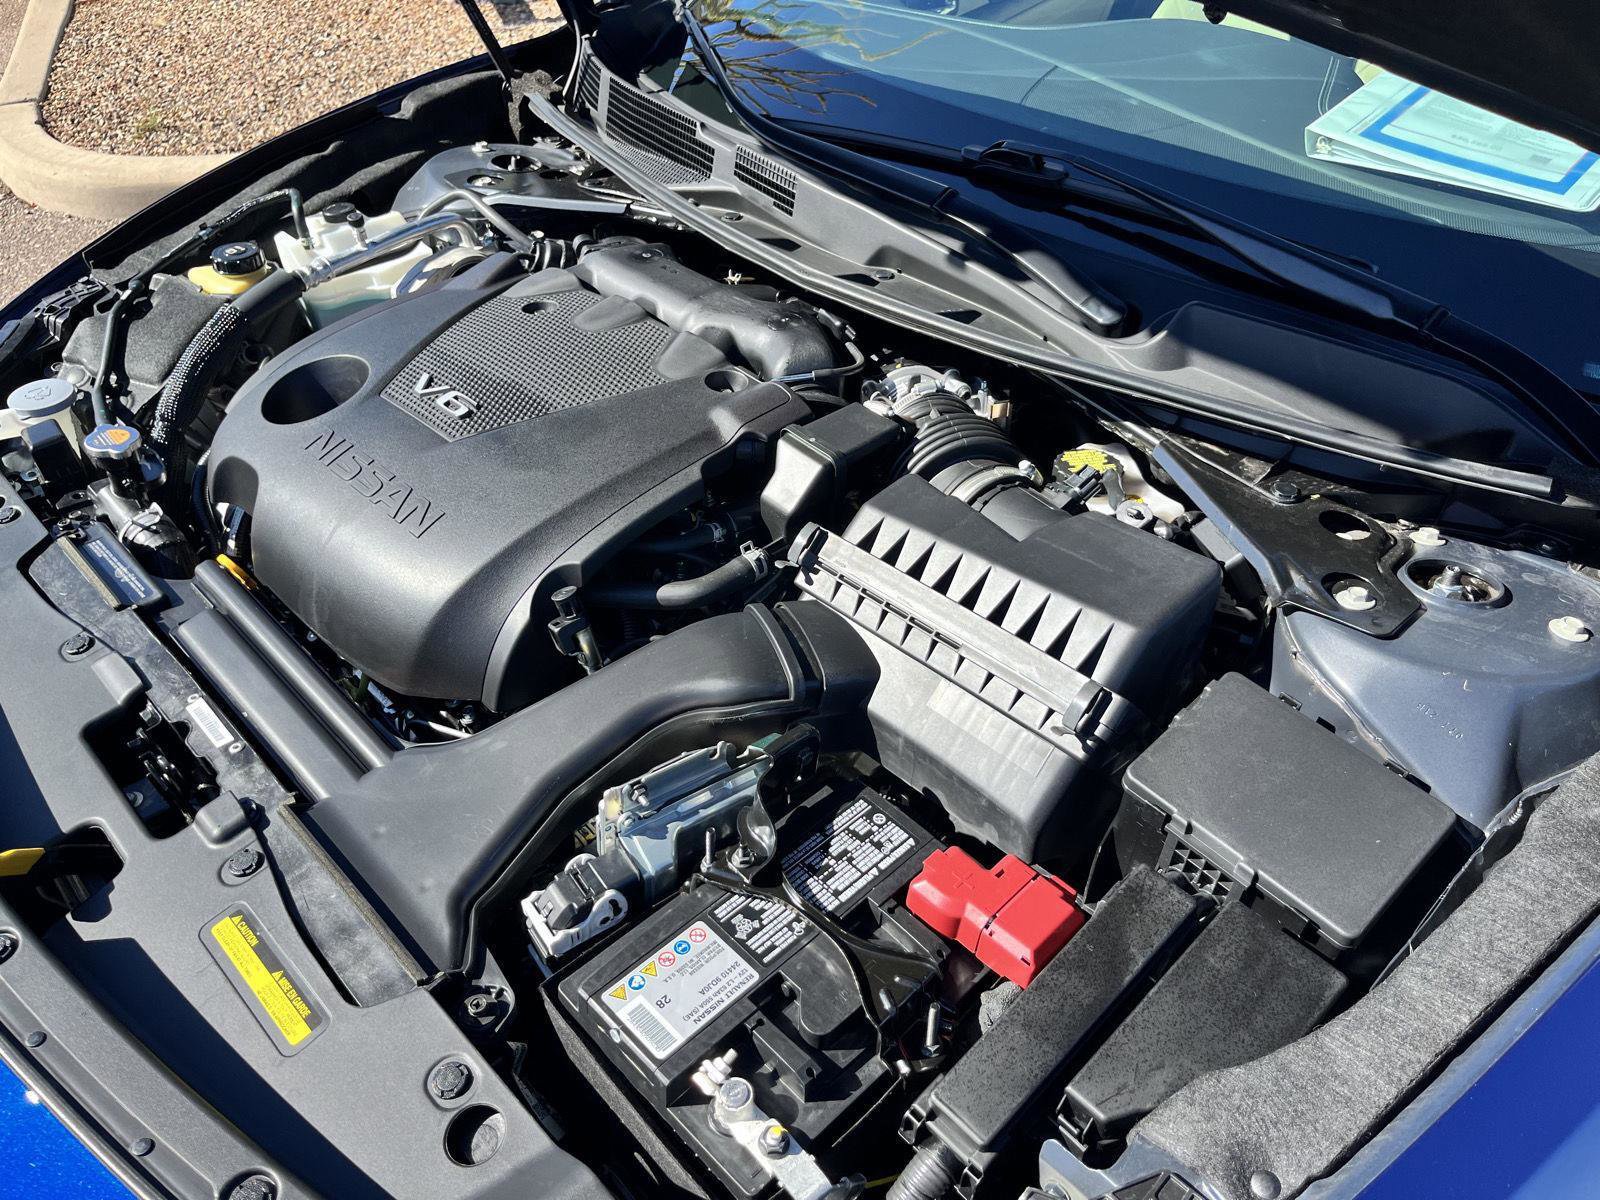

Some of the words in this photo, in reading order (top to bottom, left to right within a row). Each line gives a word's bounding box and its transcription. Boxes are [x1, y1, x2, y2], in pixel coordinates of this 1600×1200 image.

[413, 372, 480, 420] V6
[304, 429, 446, 539] NISSAN
[236, 921, 259, 947] CAUTION
[719, 960, 741, 978] 24410
[278, 976, 293, 993] MISE
[286, 988, 298, 1000] EN
[292, 996, 312, 1018] GARDE
[723, 972, 754, 998] RENAULT
[654, 993, 672, 1009] 28
[681, 1005, 700, 1022] (SAE)
[691, 996, 725, 1025] NISSAN
